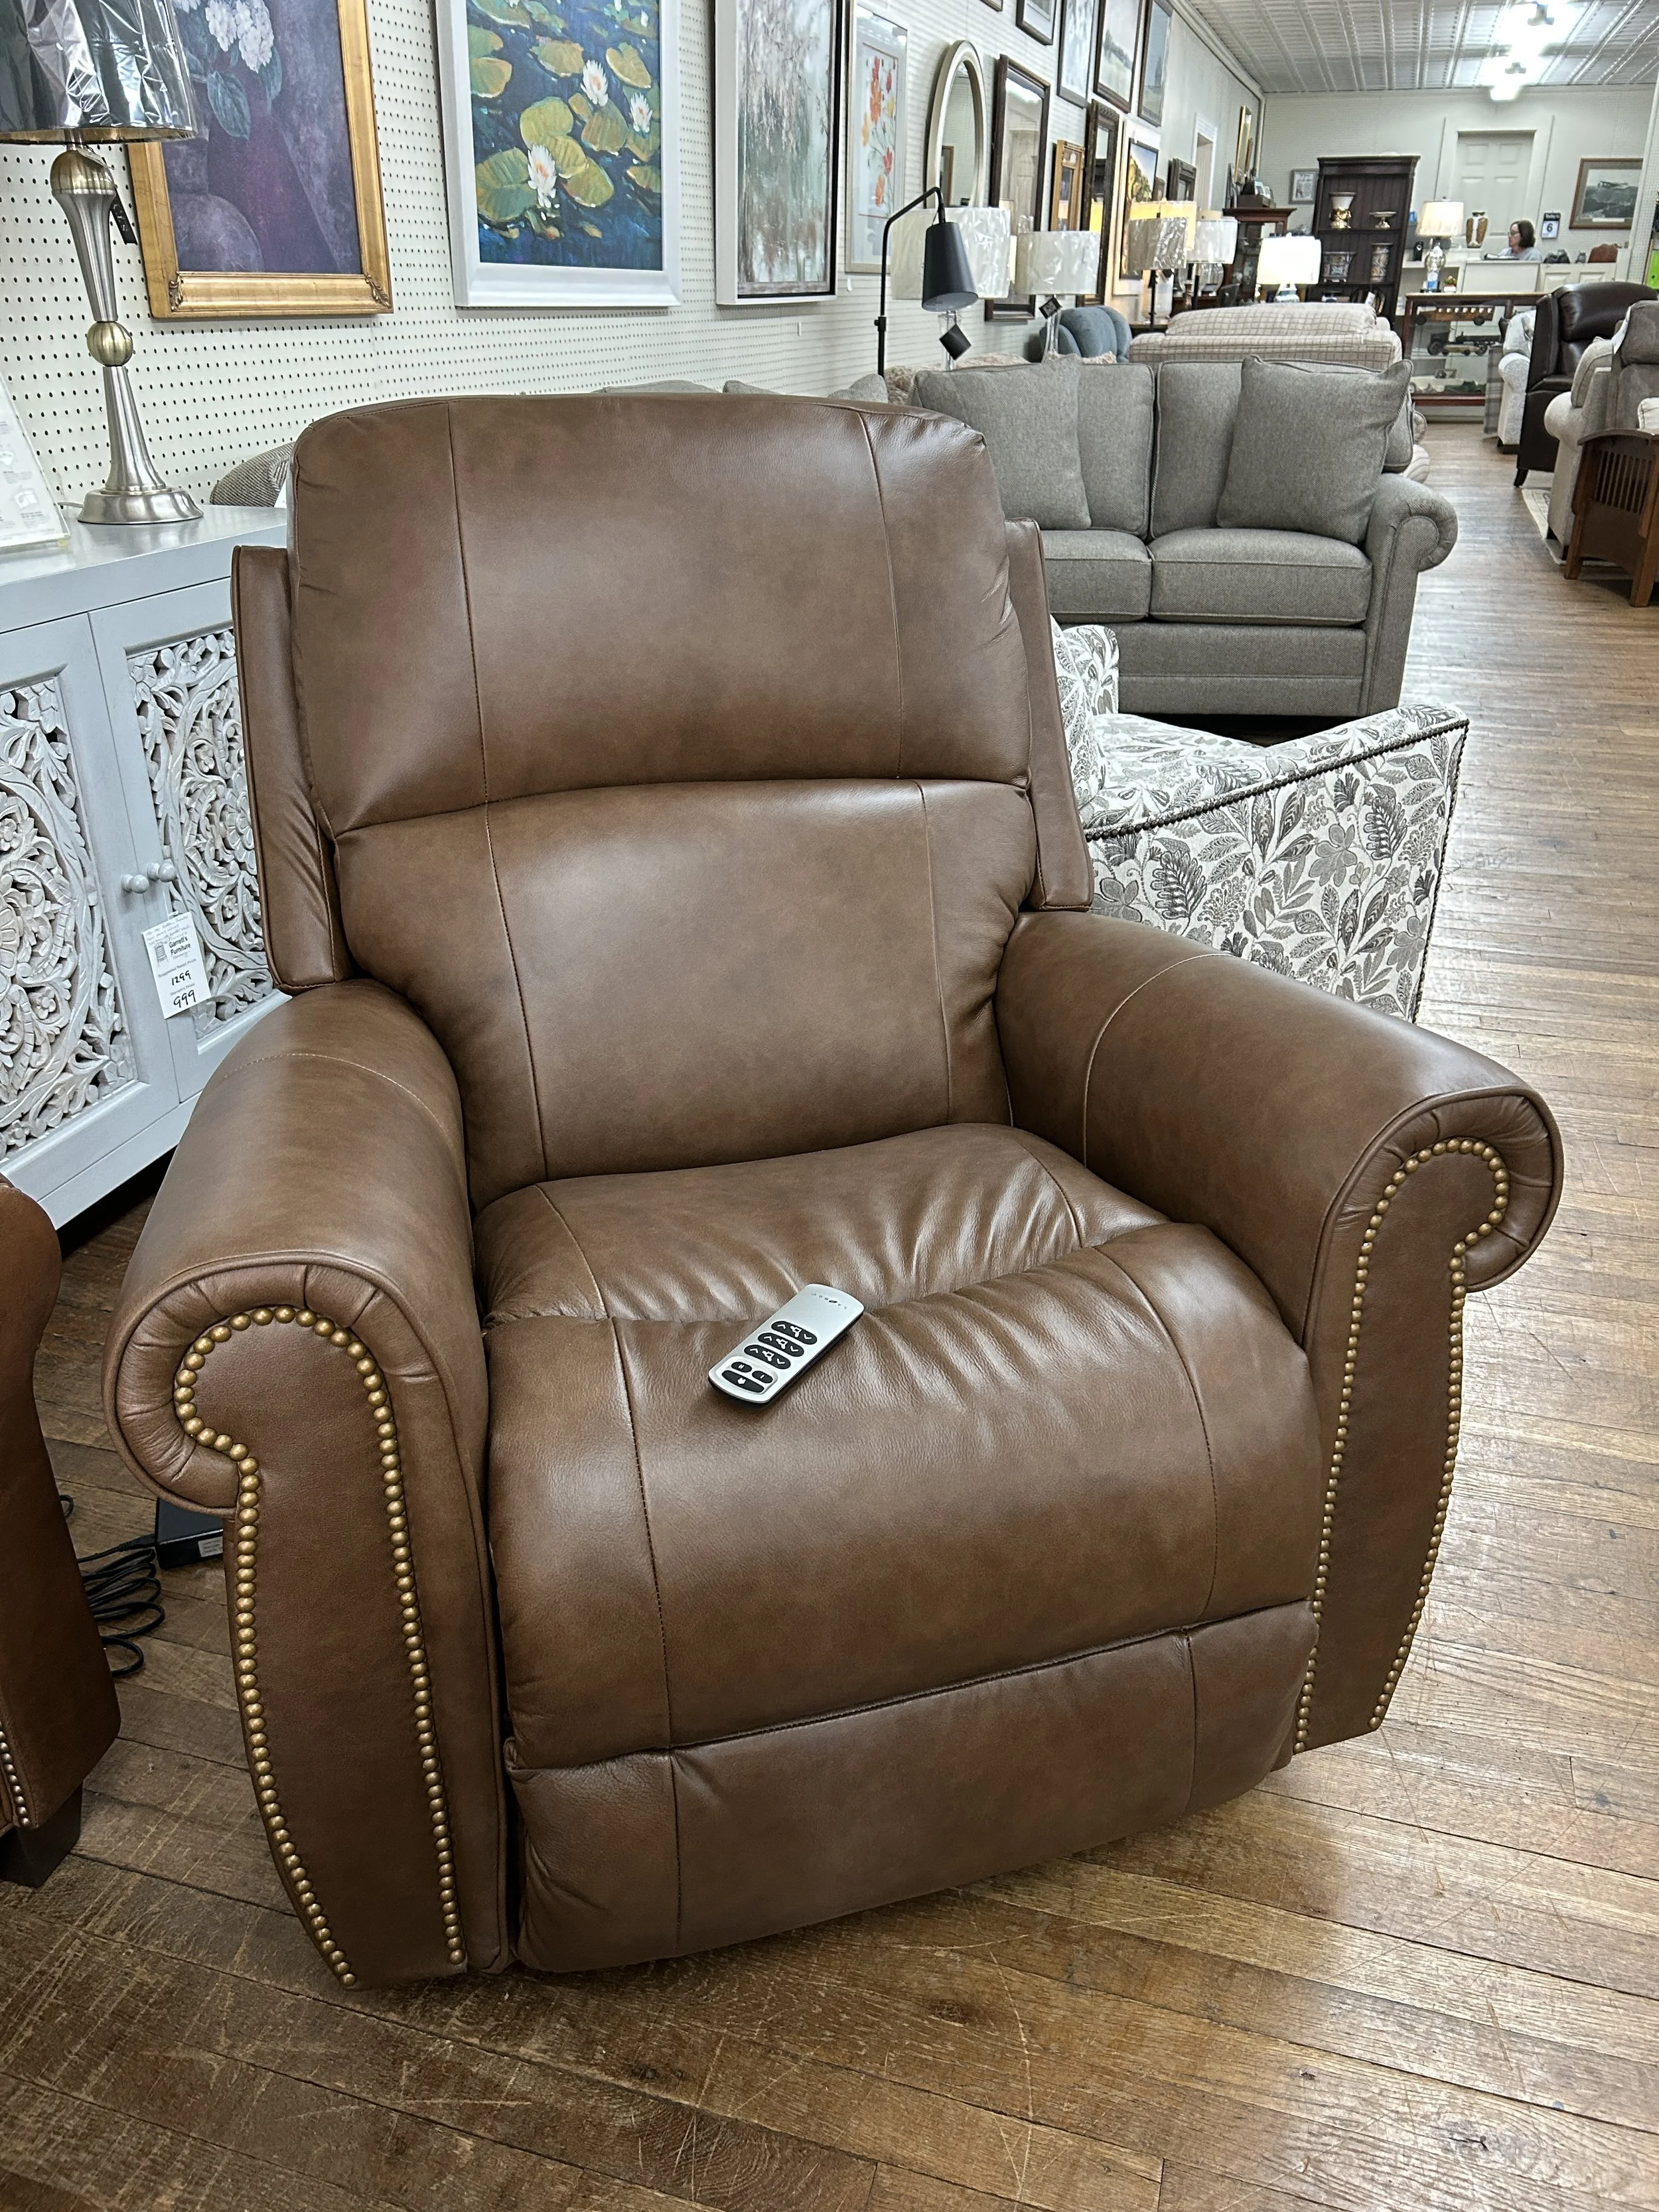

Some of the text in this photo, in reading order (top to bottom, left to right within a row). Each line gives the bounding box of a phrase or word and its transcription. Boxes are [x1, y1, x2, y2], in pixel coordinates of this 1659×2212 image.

[1547, 223, 1553, 232] 6
[171, 943, 191, 956] Furniture
[171, 970, 191, 986] 1299
[173, 990, 196, 1008] 999
